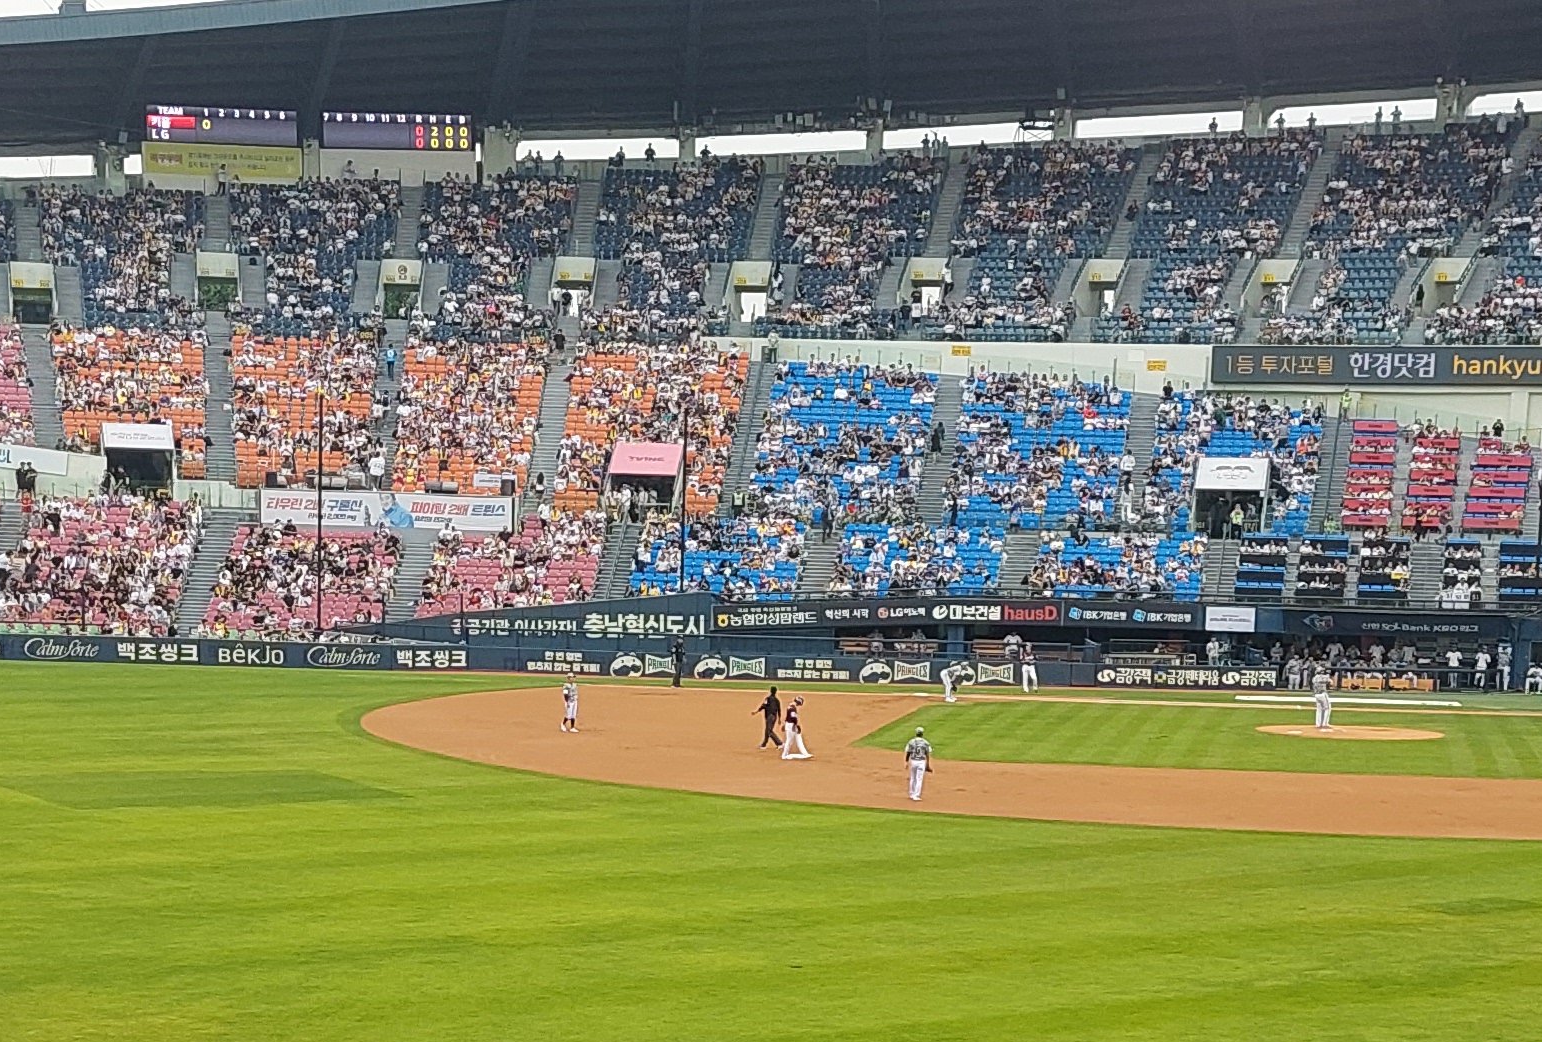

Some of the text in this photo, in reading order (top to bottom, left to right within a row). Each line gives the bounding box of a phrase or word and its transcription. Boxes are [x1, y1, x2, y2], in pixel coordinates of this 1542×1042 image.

[157, 106, 183, 115] TEAM
[152, 129, 170, 139] LG
[1225, 355, 1255, 374] 1등
[1260, 355, 1333, 375] 투자포털
[1349, 352, 1436, 377] 한경닷컴
[949, 605, 1001, 621] 대보건설
[583, 613, 705, 638] 충남혁신도시
[117, 641, 199, 662] 백조씽크
[396, 648, 468, 668] 백조씽크
[1115, 667, 1152, 684] 금강주택
[1240, 670, 1277, 687] 금강주택
